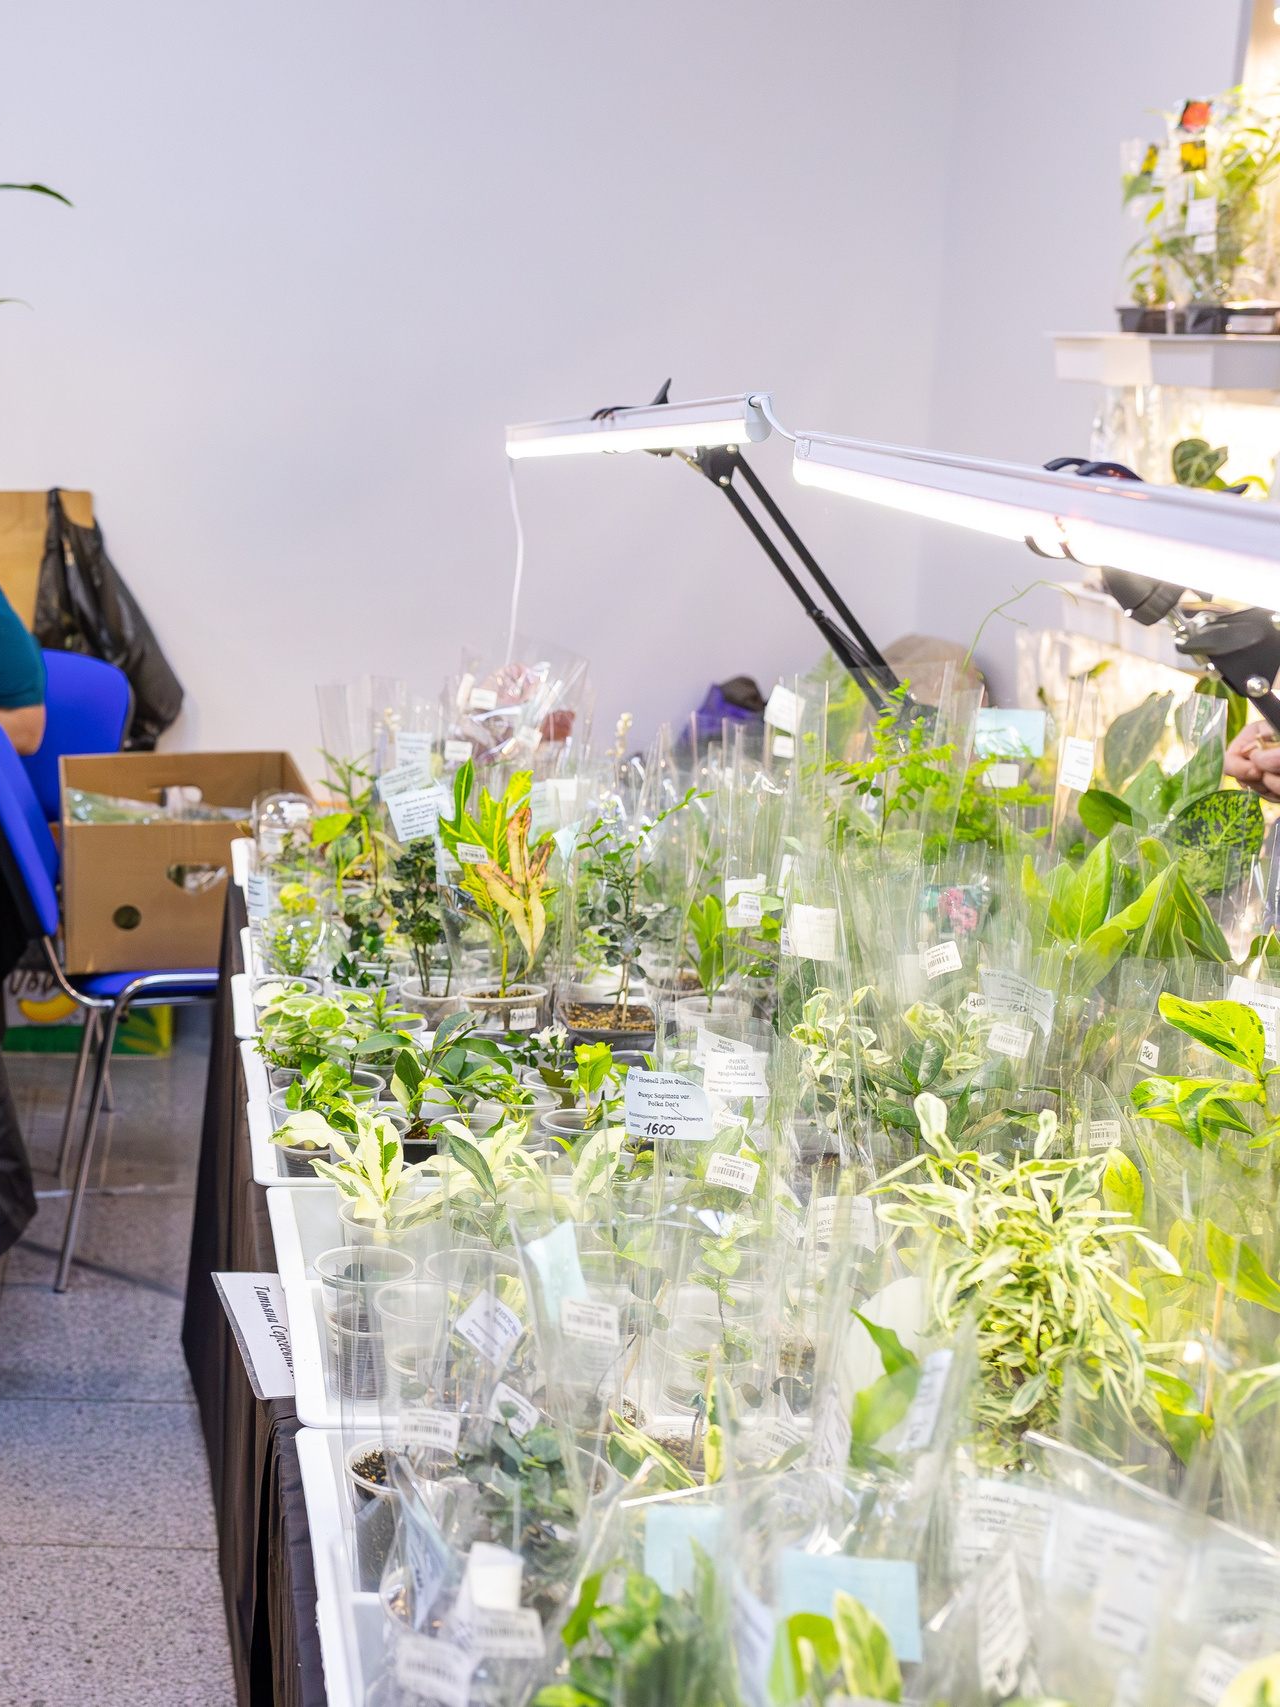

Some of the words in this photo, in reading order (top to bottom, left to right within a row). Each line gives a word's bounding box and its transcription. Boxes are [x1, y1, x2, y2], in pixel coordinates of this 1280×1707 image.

[637, 1091, 653, 1099] Фикус
[644, 1122, 675, 1136] 1600
[254, 1285, 279, 1323] Татьяна
